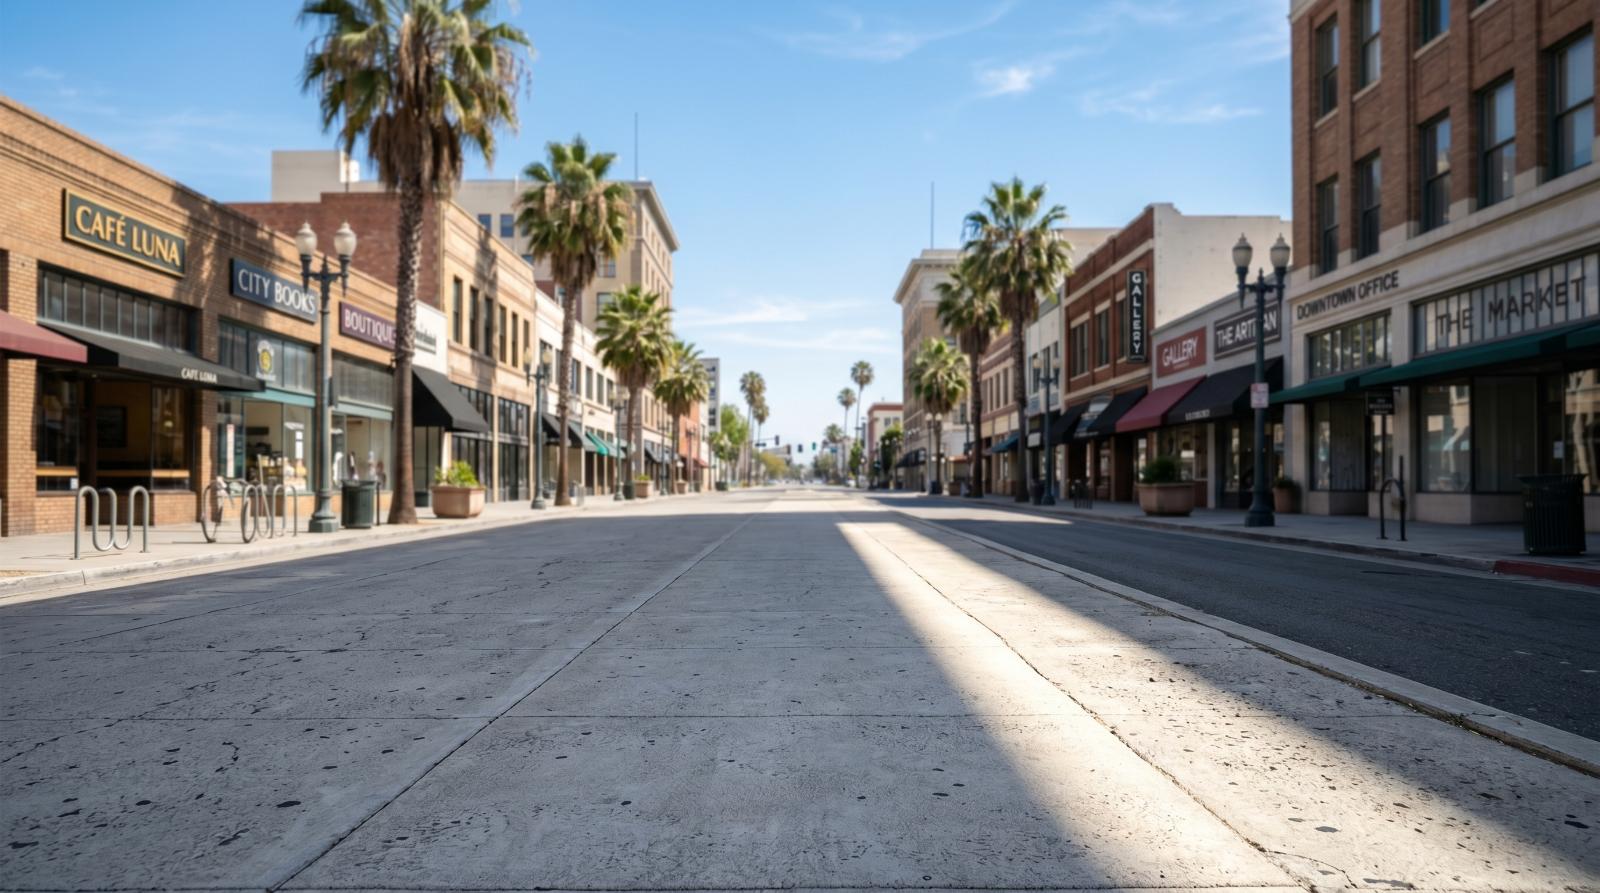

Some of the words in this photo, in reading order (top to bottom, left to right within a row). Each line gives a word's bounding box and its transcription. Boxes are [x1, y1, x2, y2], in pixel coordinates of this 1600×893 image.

[76, 205, 126, 247] CAFÉ
[132, 225, 181, 267] LUNA
[238, 268, 271, 299] CITY
[275, 281, 316, 315] BOOKS
[1131, 272, 1142, 354] GALLERY
[1297, 286, 1356, 320] DOWNTOWN
[1358, 269, 1399, 300] OFFICE
[1437, 308, 1473, 336] THE
[1488, 276, 1586, 324] MARKET
[1162, 336, 1199, 368] GALLERY
[1216, 326, 1233, 349] THE
[1234, 310, 1278, 342] ARTIAN
